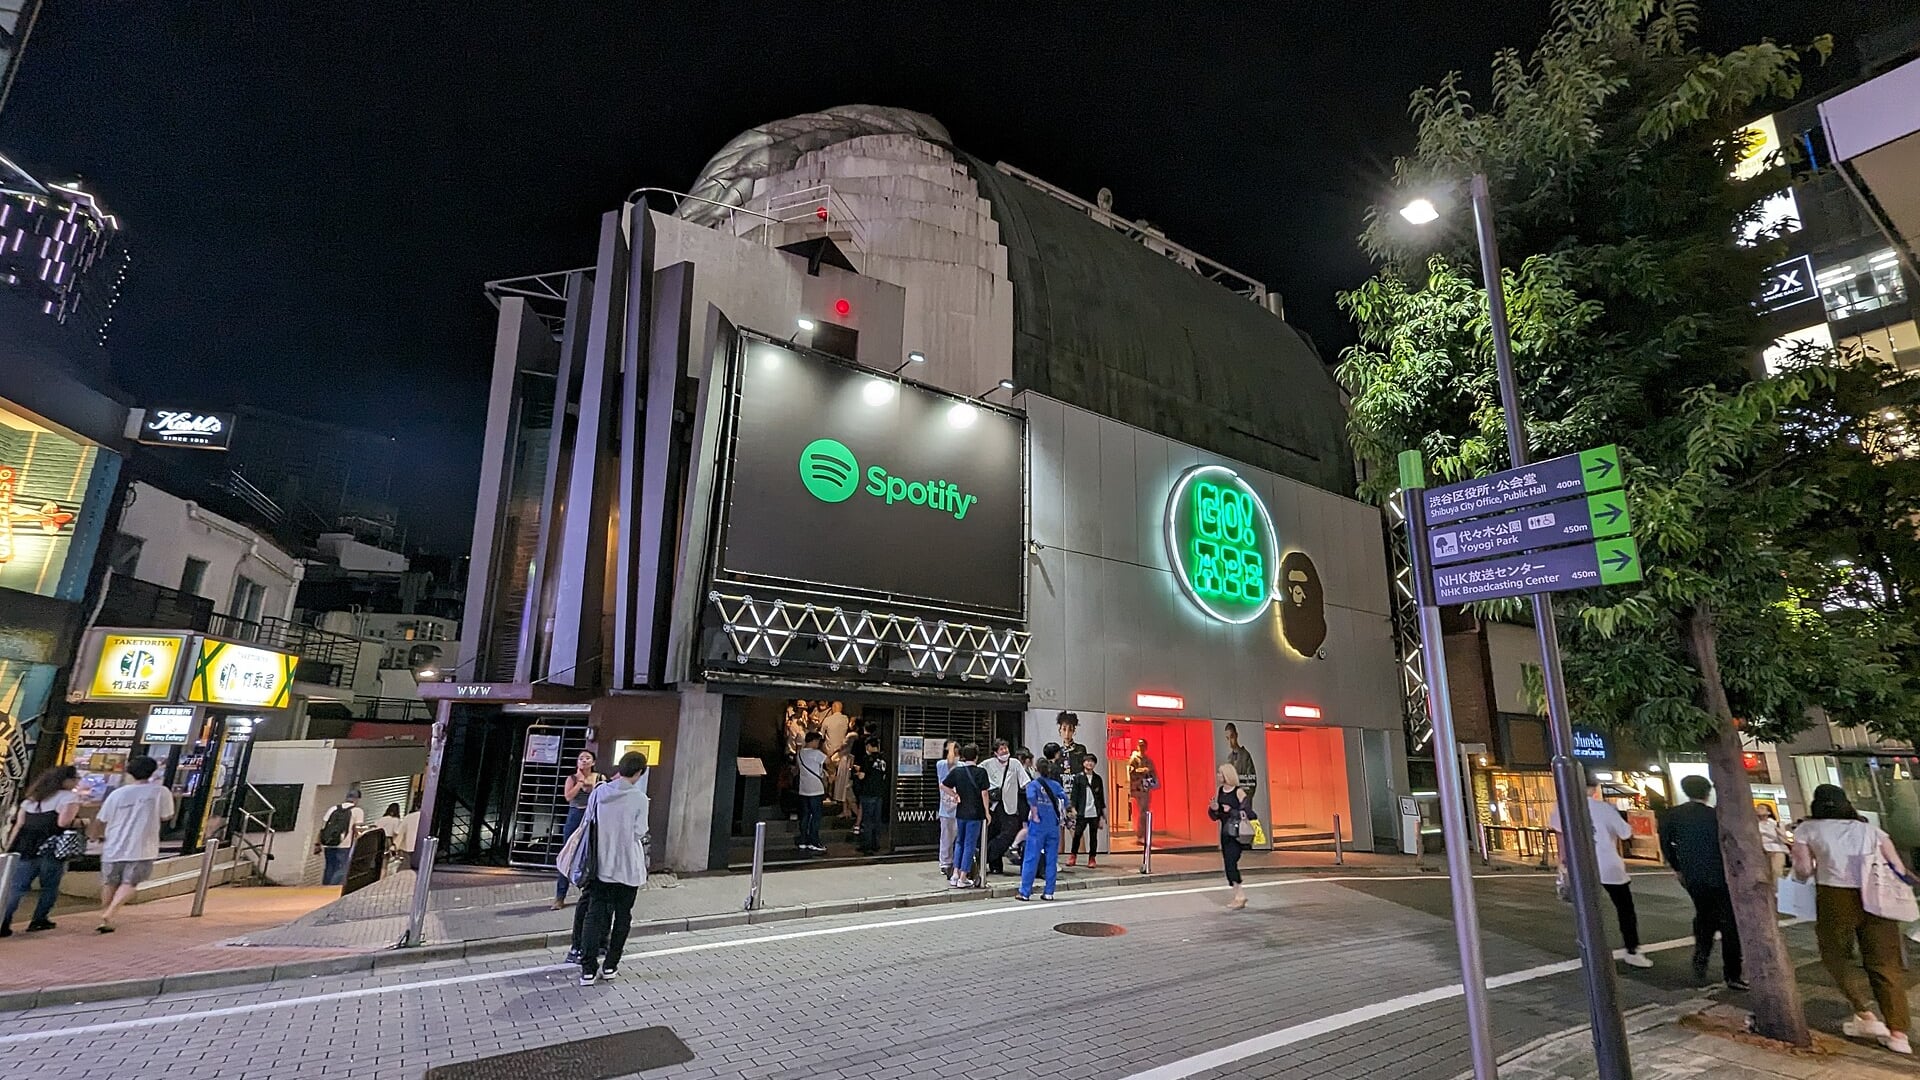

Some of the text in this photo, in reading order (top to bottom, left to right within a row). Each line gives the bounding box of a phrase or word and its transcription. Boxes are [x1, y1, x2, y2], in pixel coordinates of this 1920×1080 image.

[149, 410, 222, 432] Kiehl's
[1556, 479, 1581, 489] 400m
[1431, 484, 1547, 518] Shibuya City Office, Public Hall
[1197, 482, 1256, 547] GO!
[1458, 519, 1588, 544] 代々木公園 450m
[1460, 535, 1519, 554] Yoyogi Park
[1194, 538, 1265, 601] APE
[1439, 562, 1597, 587] NHK放送センター 450m
[1441, 574, 1560, 598] NHK Broadcasting Center
[113, 639, 173, 647] TAKETORIYA
[112, 680, 150, 690] 竹取屋
[457, 686, 491, 695] WWW
